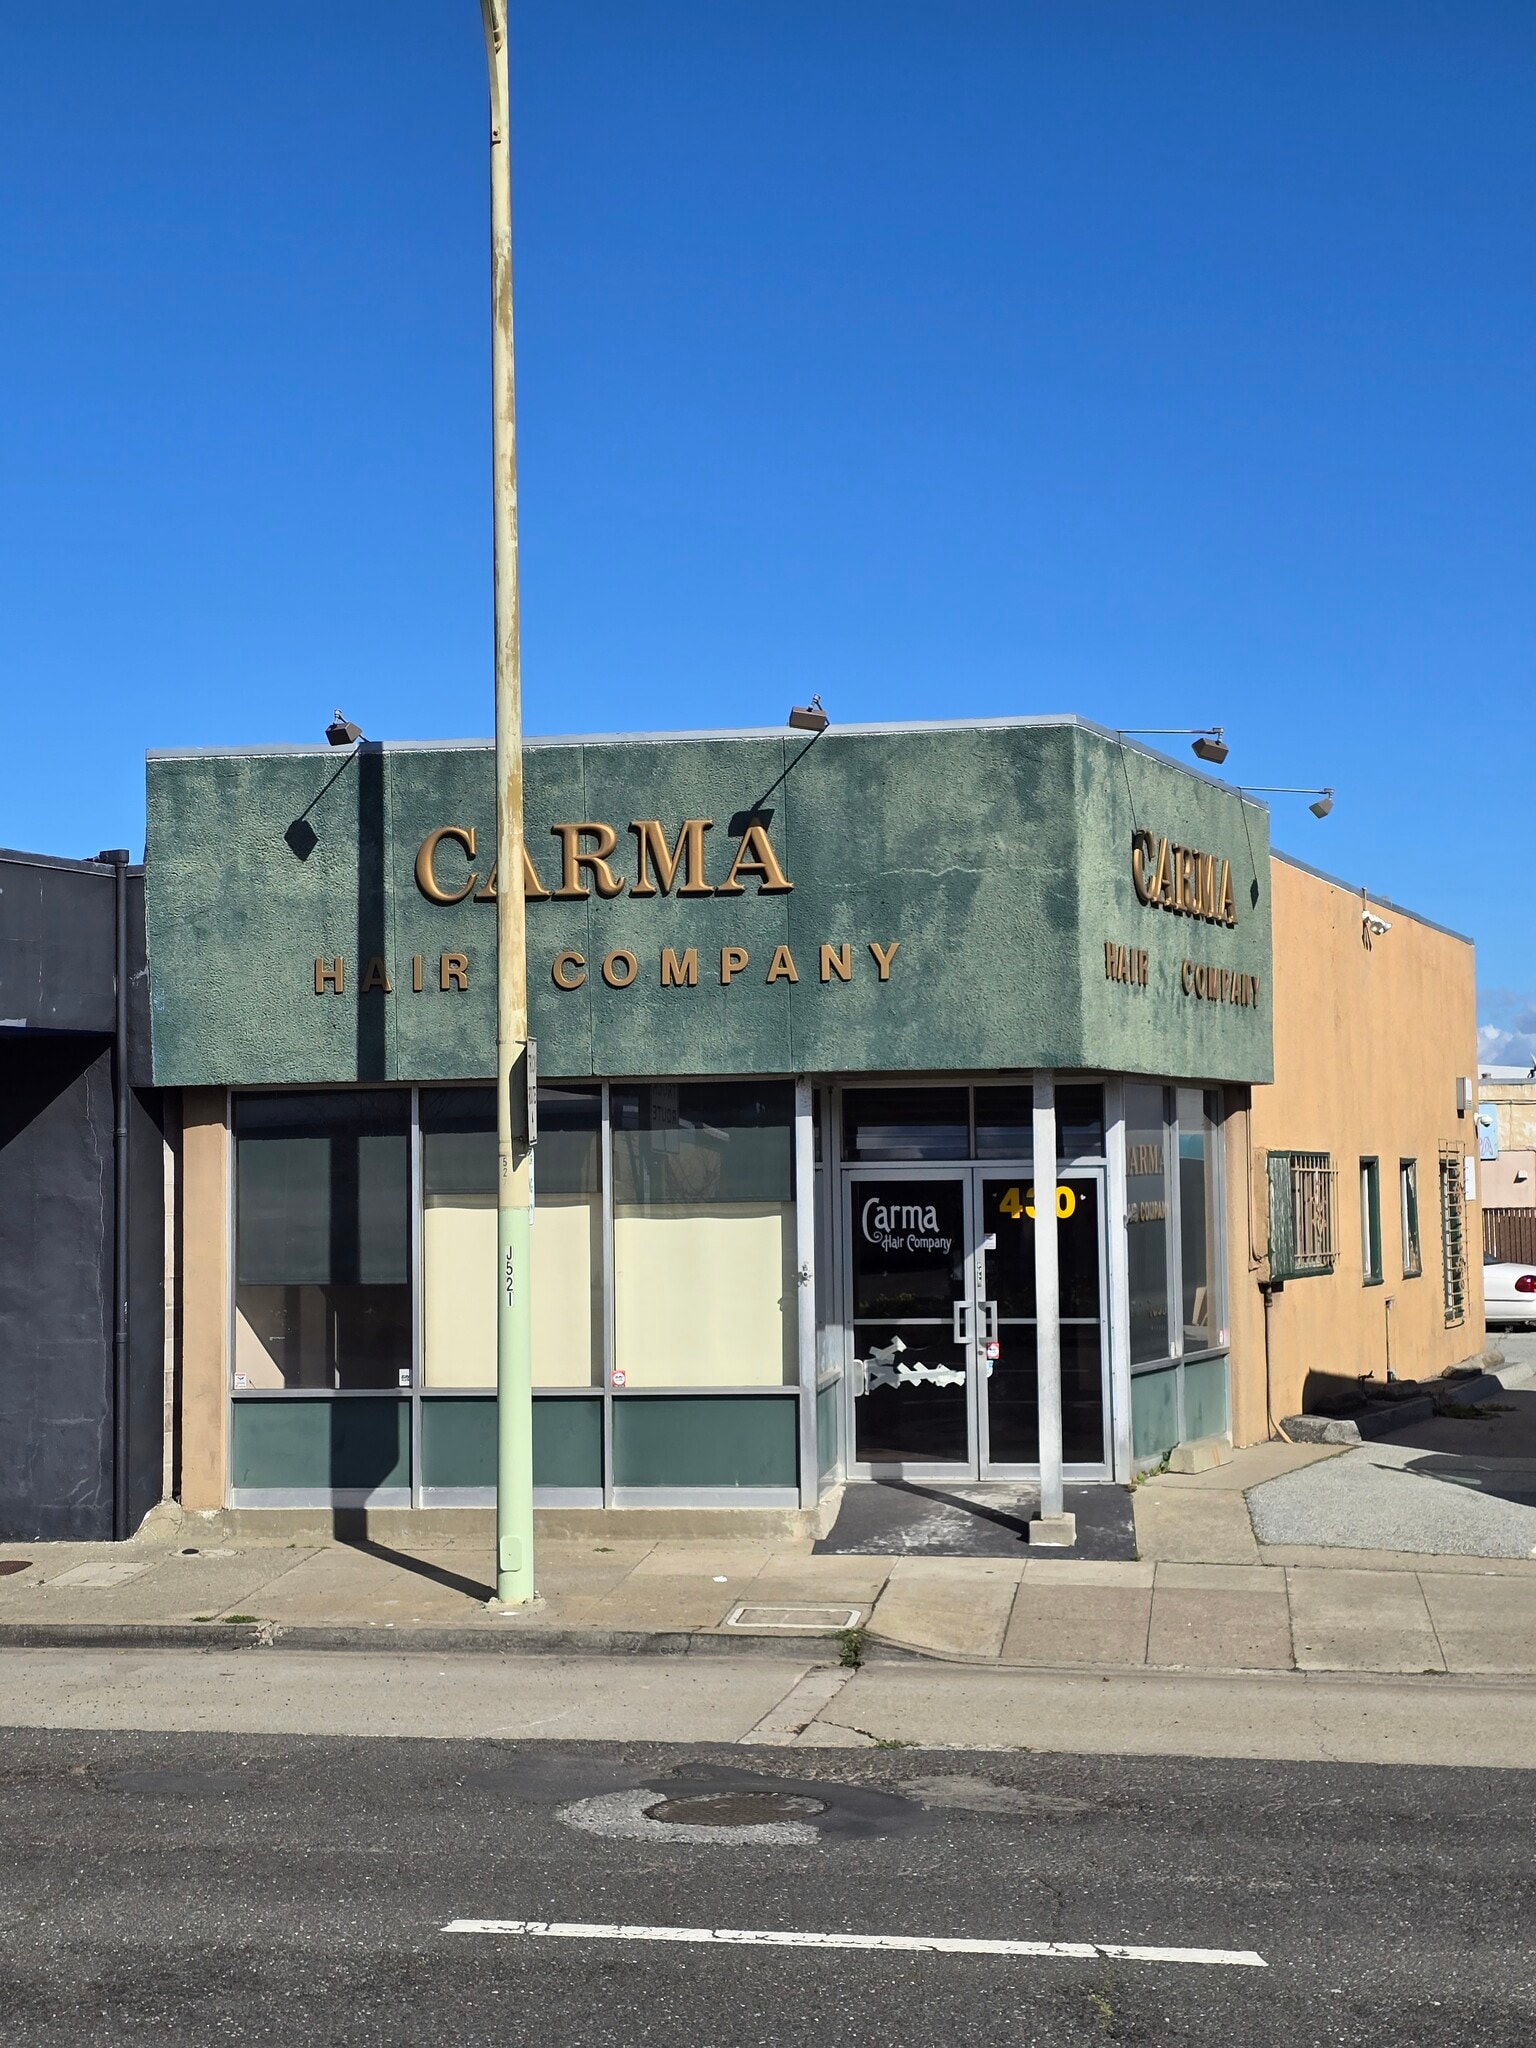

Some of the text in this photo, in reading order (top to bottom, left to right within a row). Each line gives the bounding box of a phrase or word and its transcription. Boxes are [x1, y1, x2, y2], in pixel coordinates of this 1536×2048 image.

[415, 818, 793, 903] CARMA
[1131, 827, 1238, 926] CARMA
[315, 943, 899, 993] HAIR COMPANY
[1105, 941, 1259, 1007] HAIR COMPANY
[862, 1197, 940, 1243] Carma
[881, 1233, 952, 1255] Hair Company
